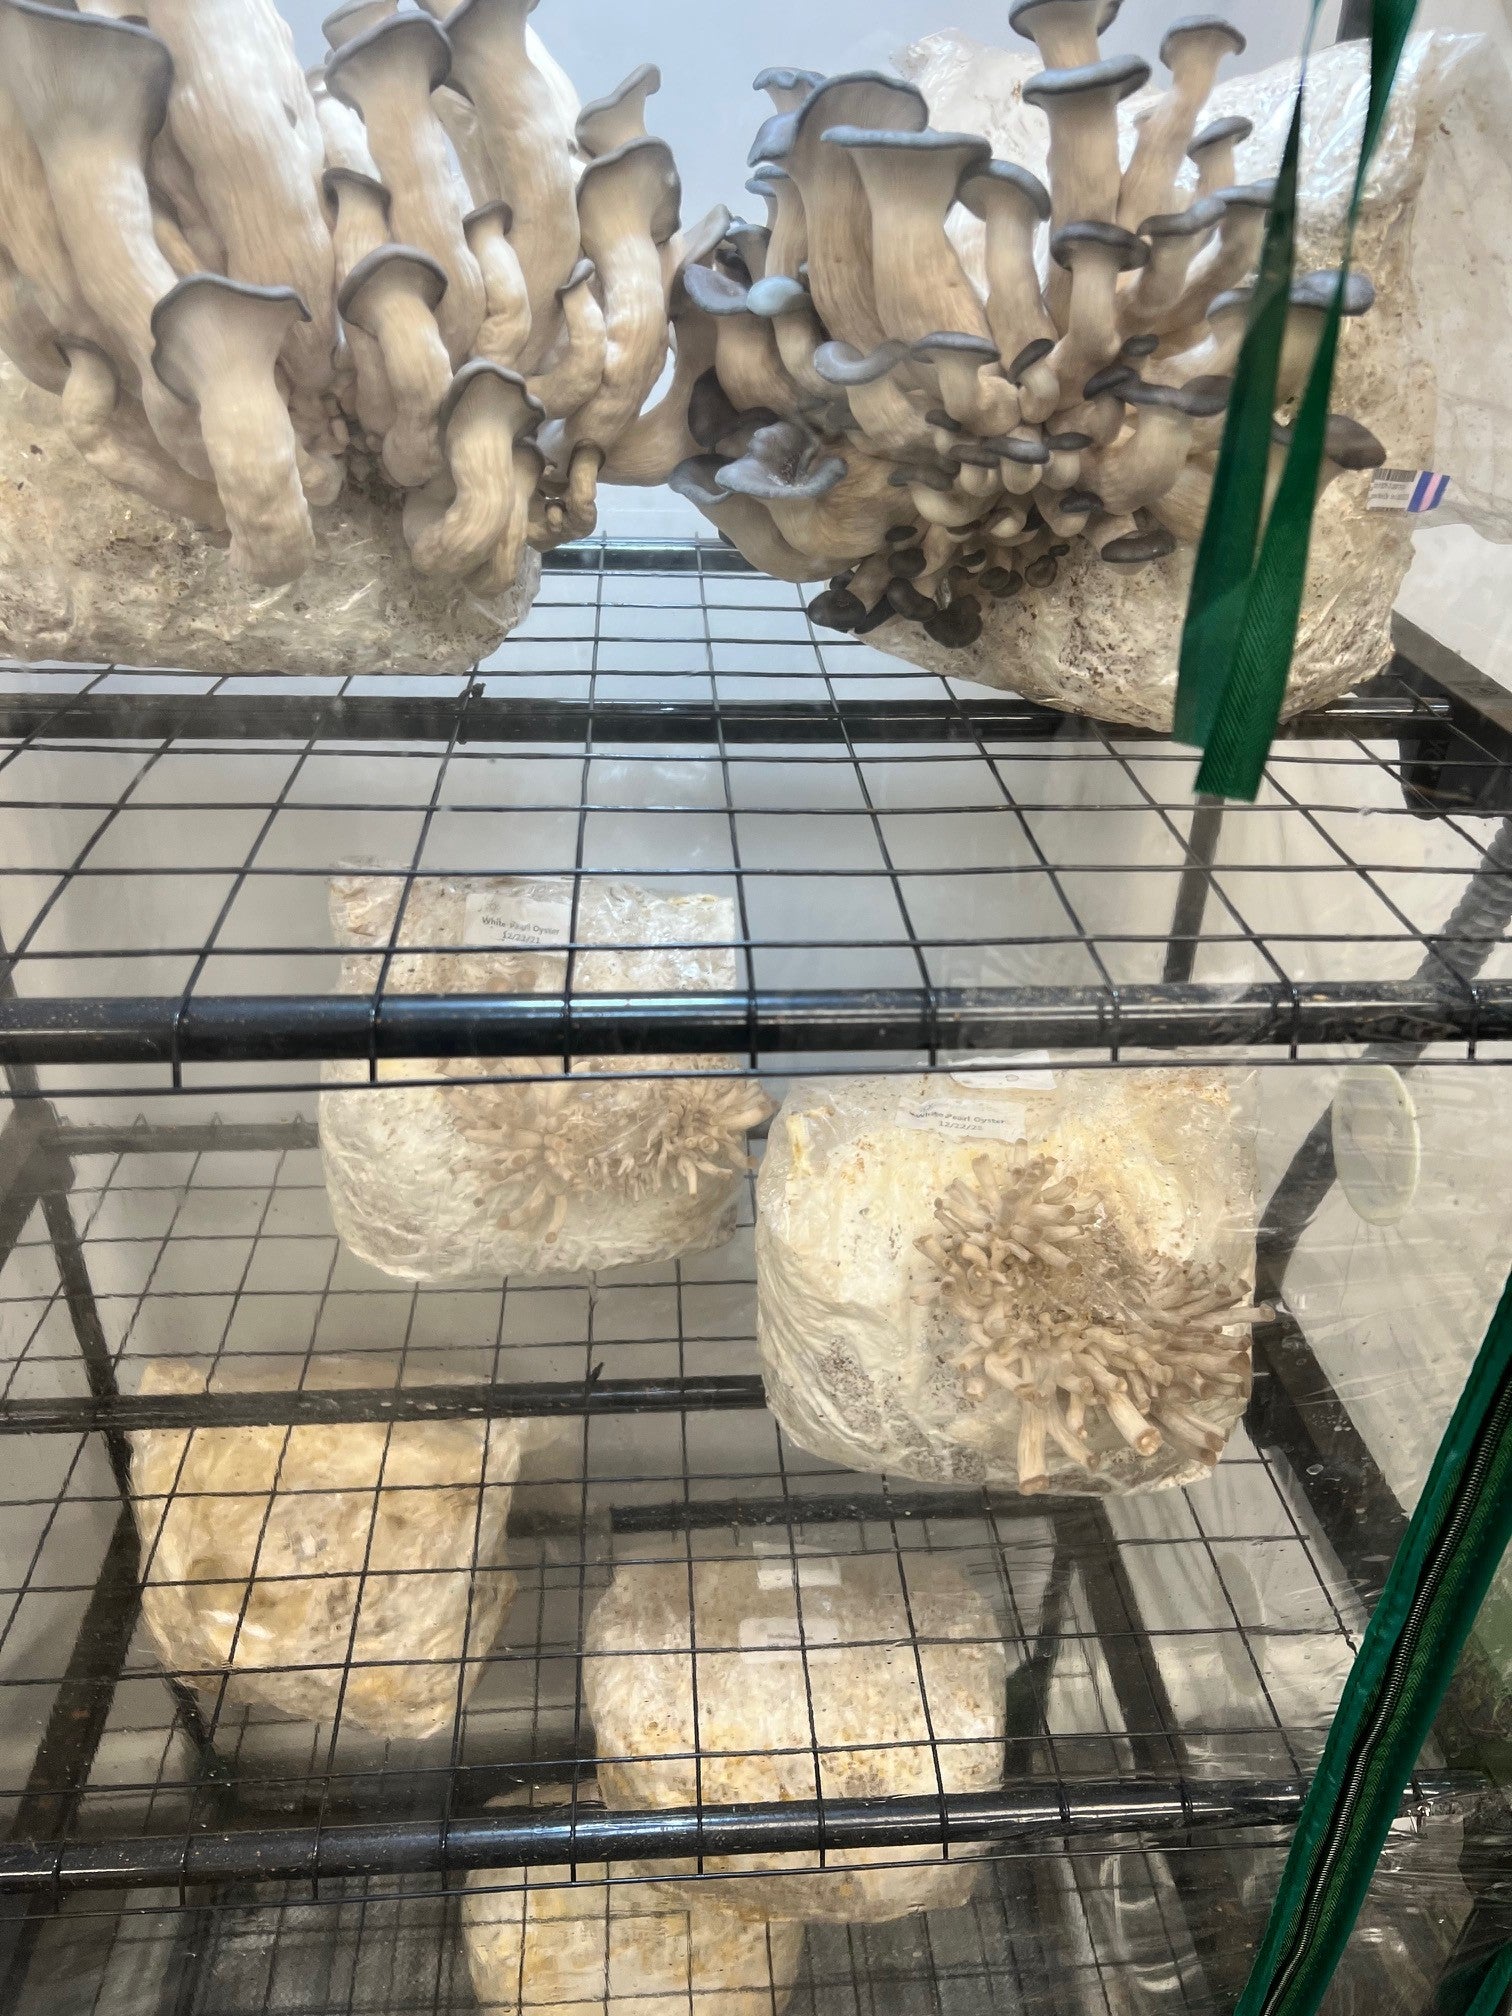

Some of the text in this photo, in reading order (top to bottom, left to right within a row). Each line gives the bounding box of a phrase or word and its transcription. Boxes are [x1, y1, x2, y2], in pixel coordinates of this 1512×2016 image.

[481, 916, 506, 928] White
[944, 1113, 971, 1121] Pearl
[973, 1116, 1005, 1124] Oyster
